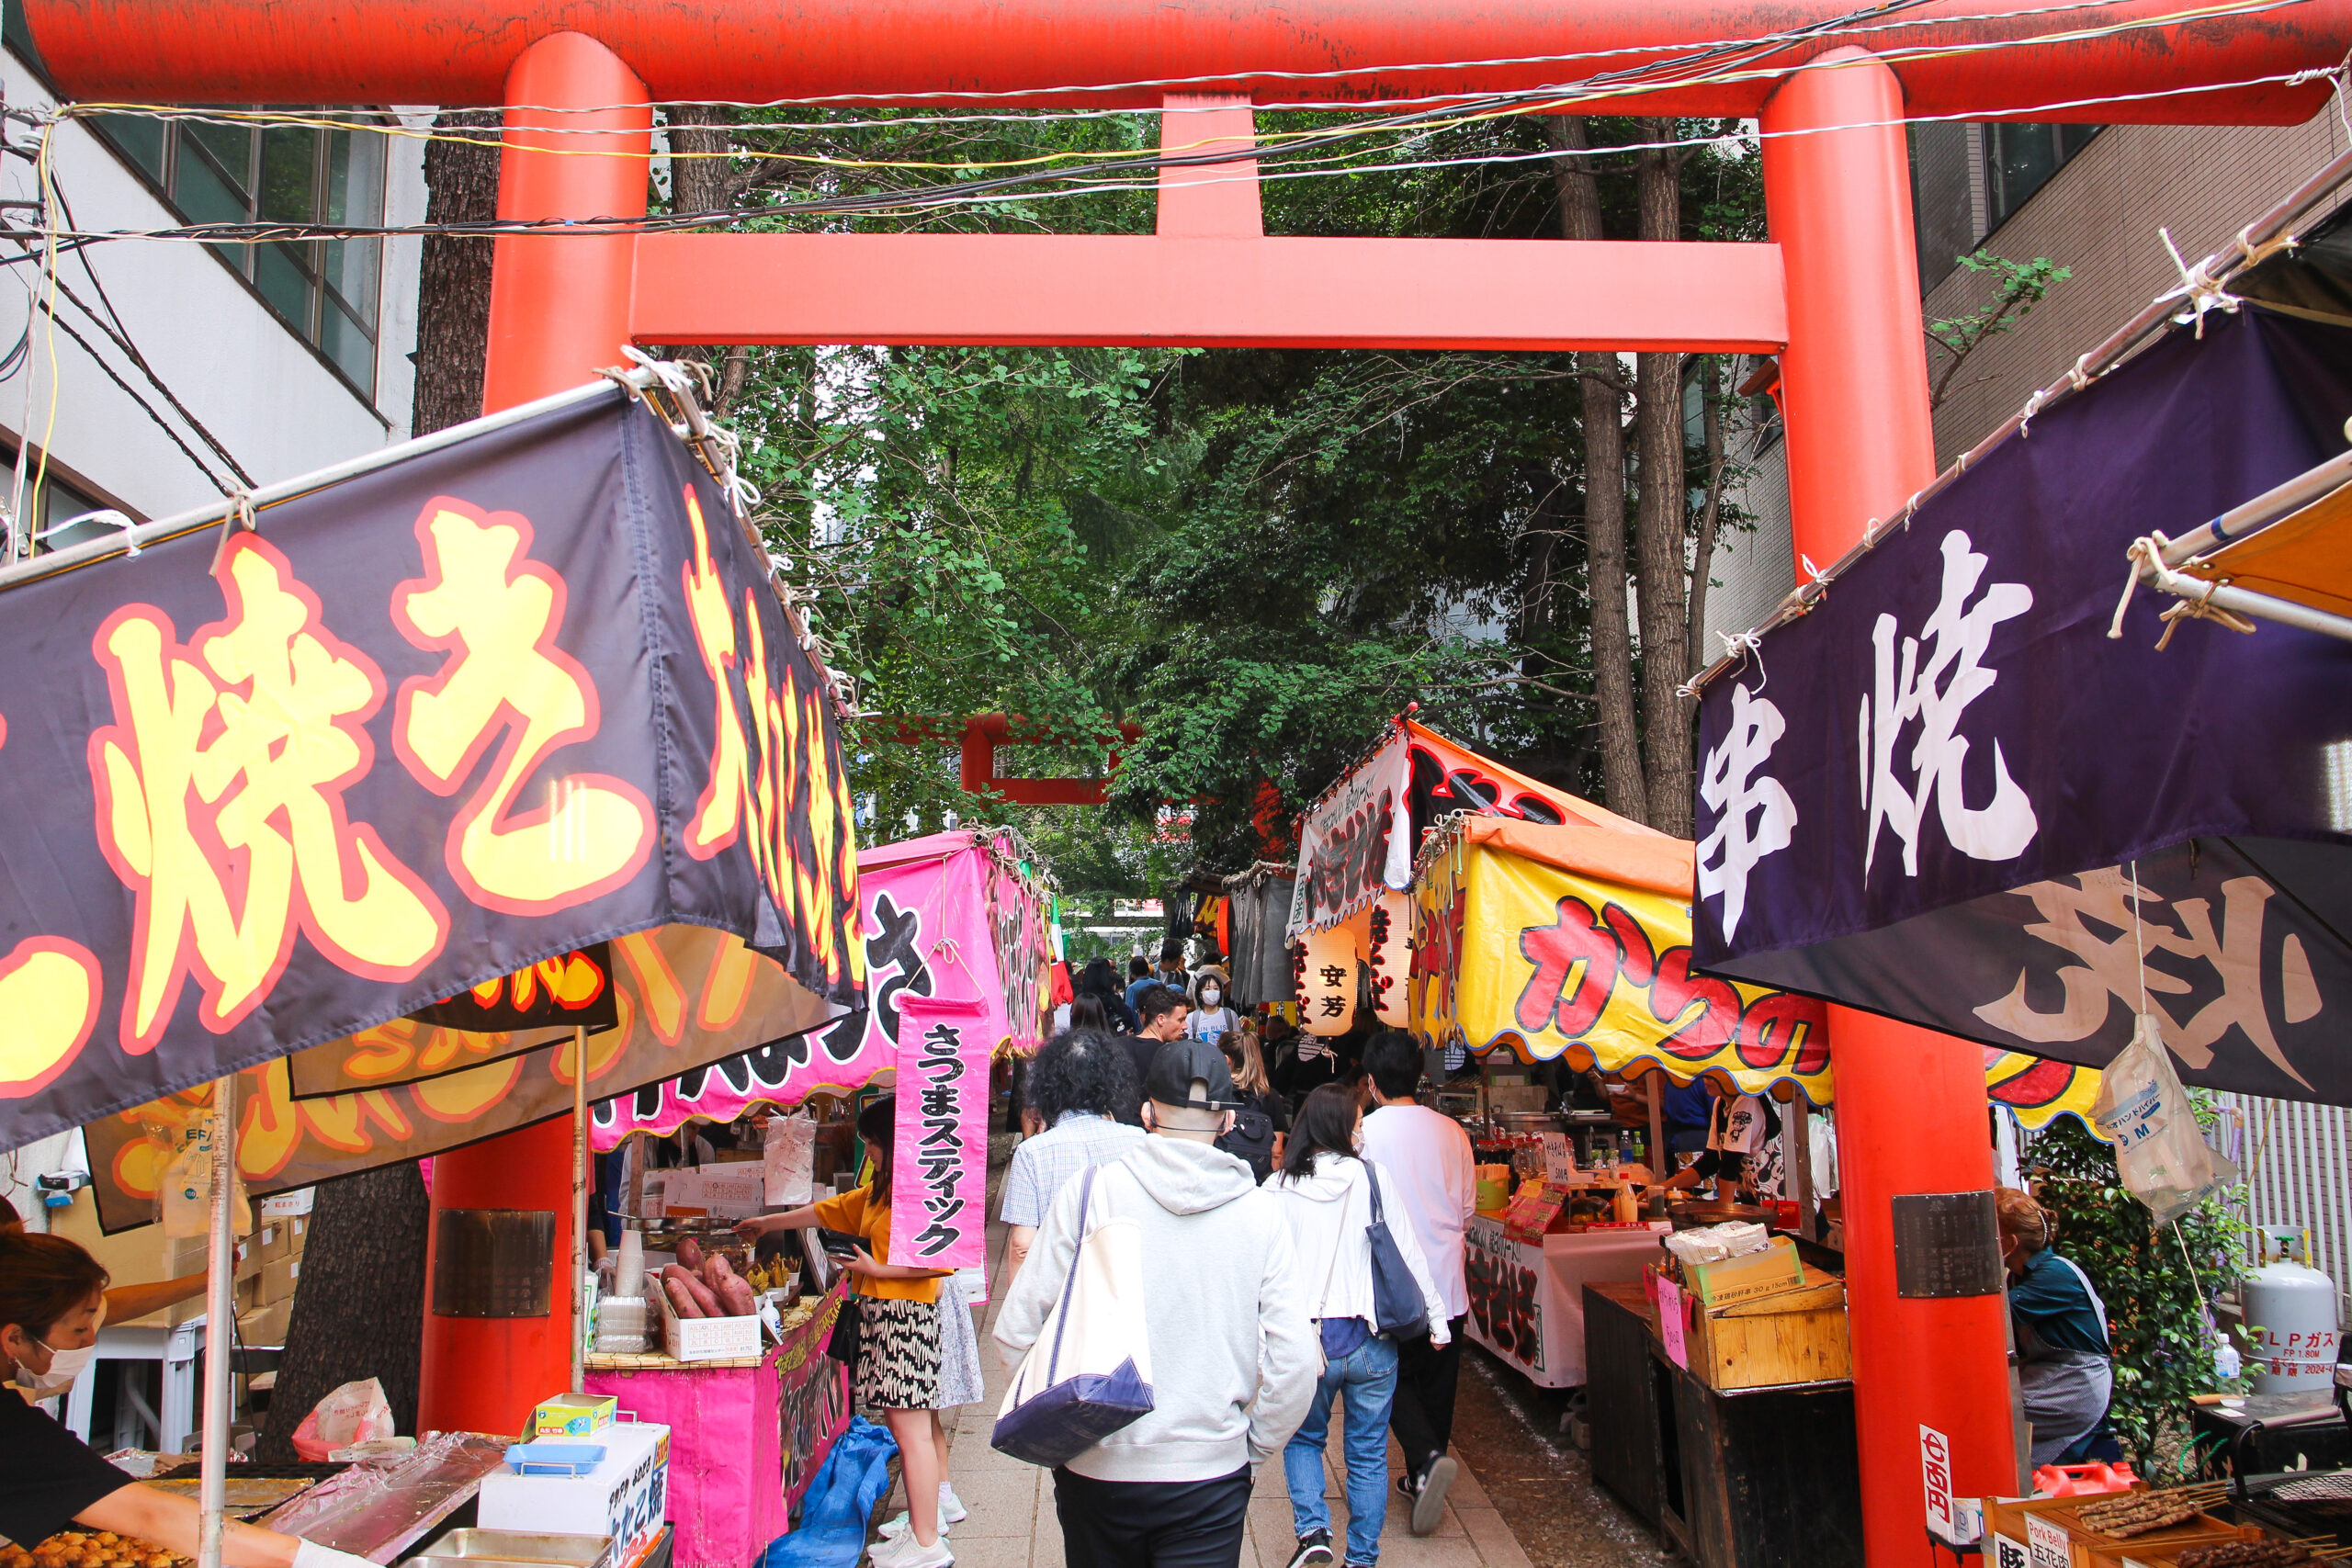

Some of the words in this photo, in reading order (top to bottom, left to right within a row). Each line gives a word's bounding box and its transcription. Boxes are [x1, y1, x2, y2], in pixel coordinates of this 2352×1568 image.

[1319, 964, 1347, 1018] 安芳
[916, 1023, 966, 1258] さつまスティック
[1464, 1247, 1538, 1367] きそば
[2028, 1521, 2048, 1542] Pork
[2047, 1529, 2066, 1555] Belly
